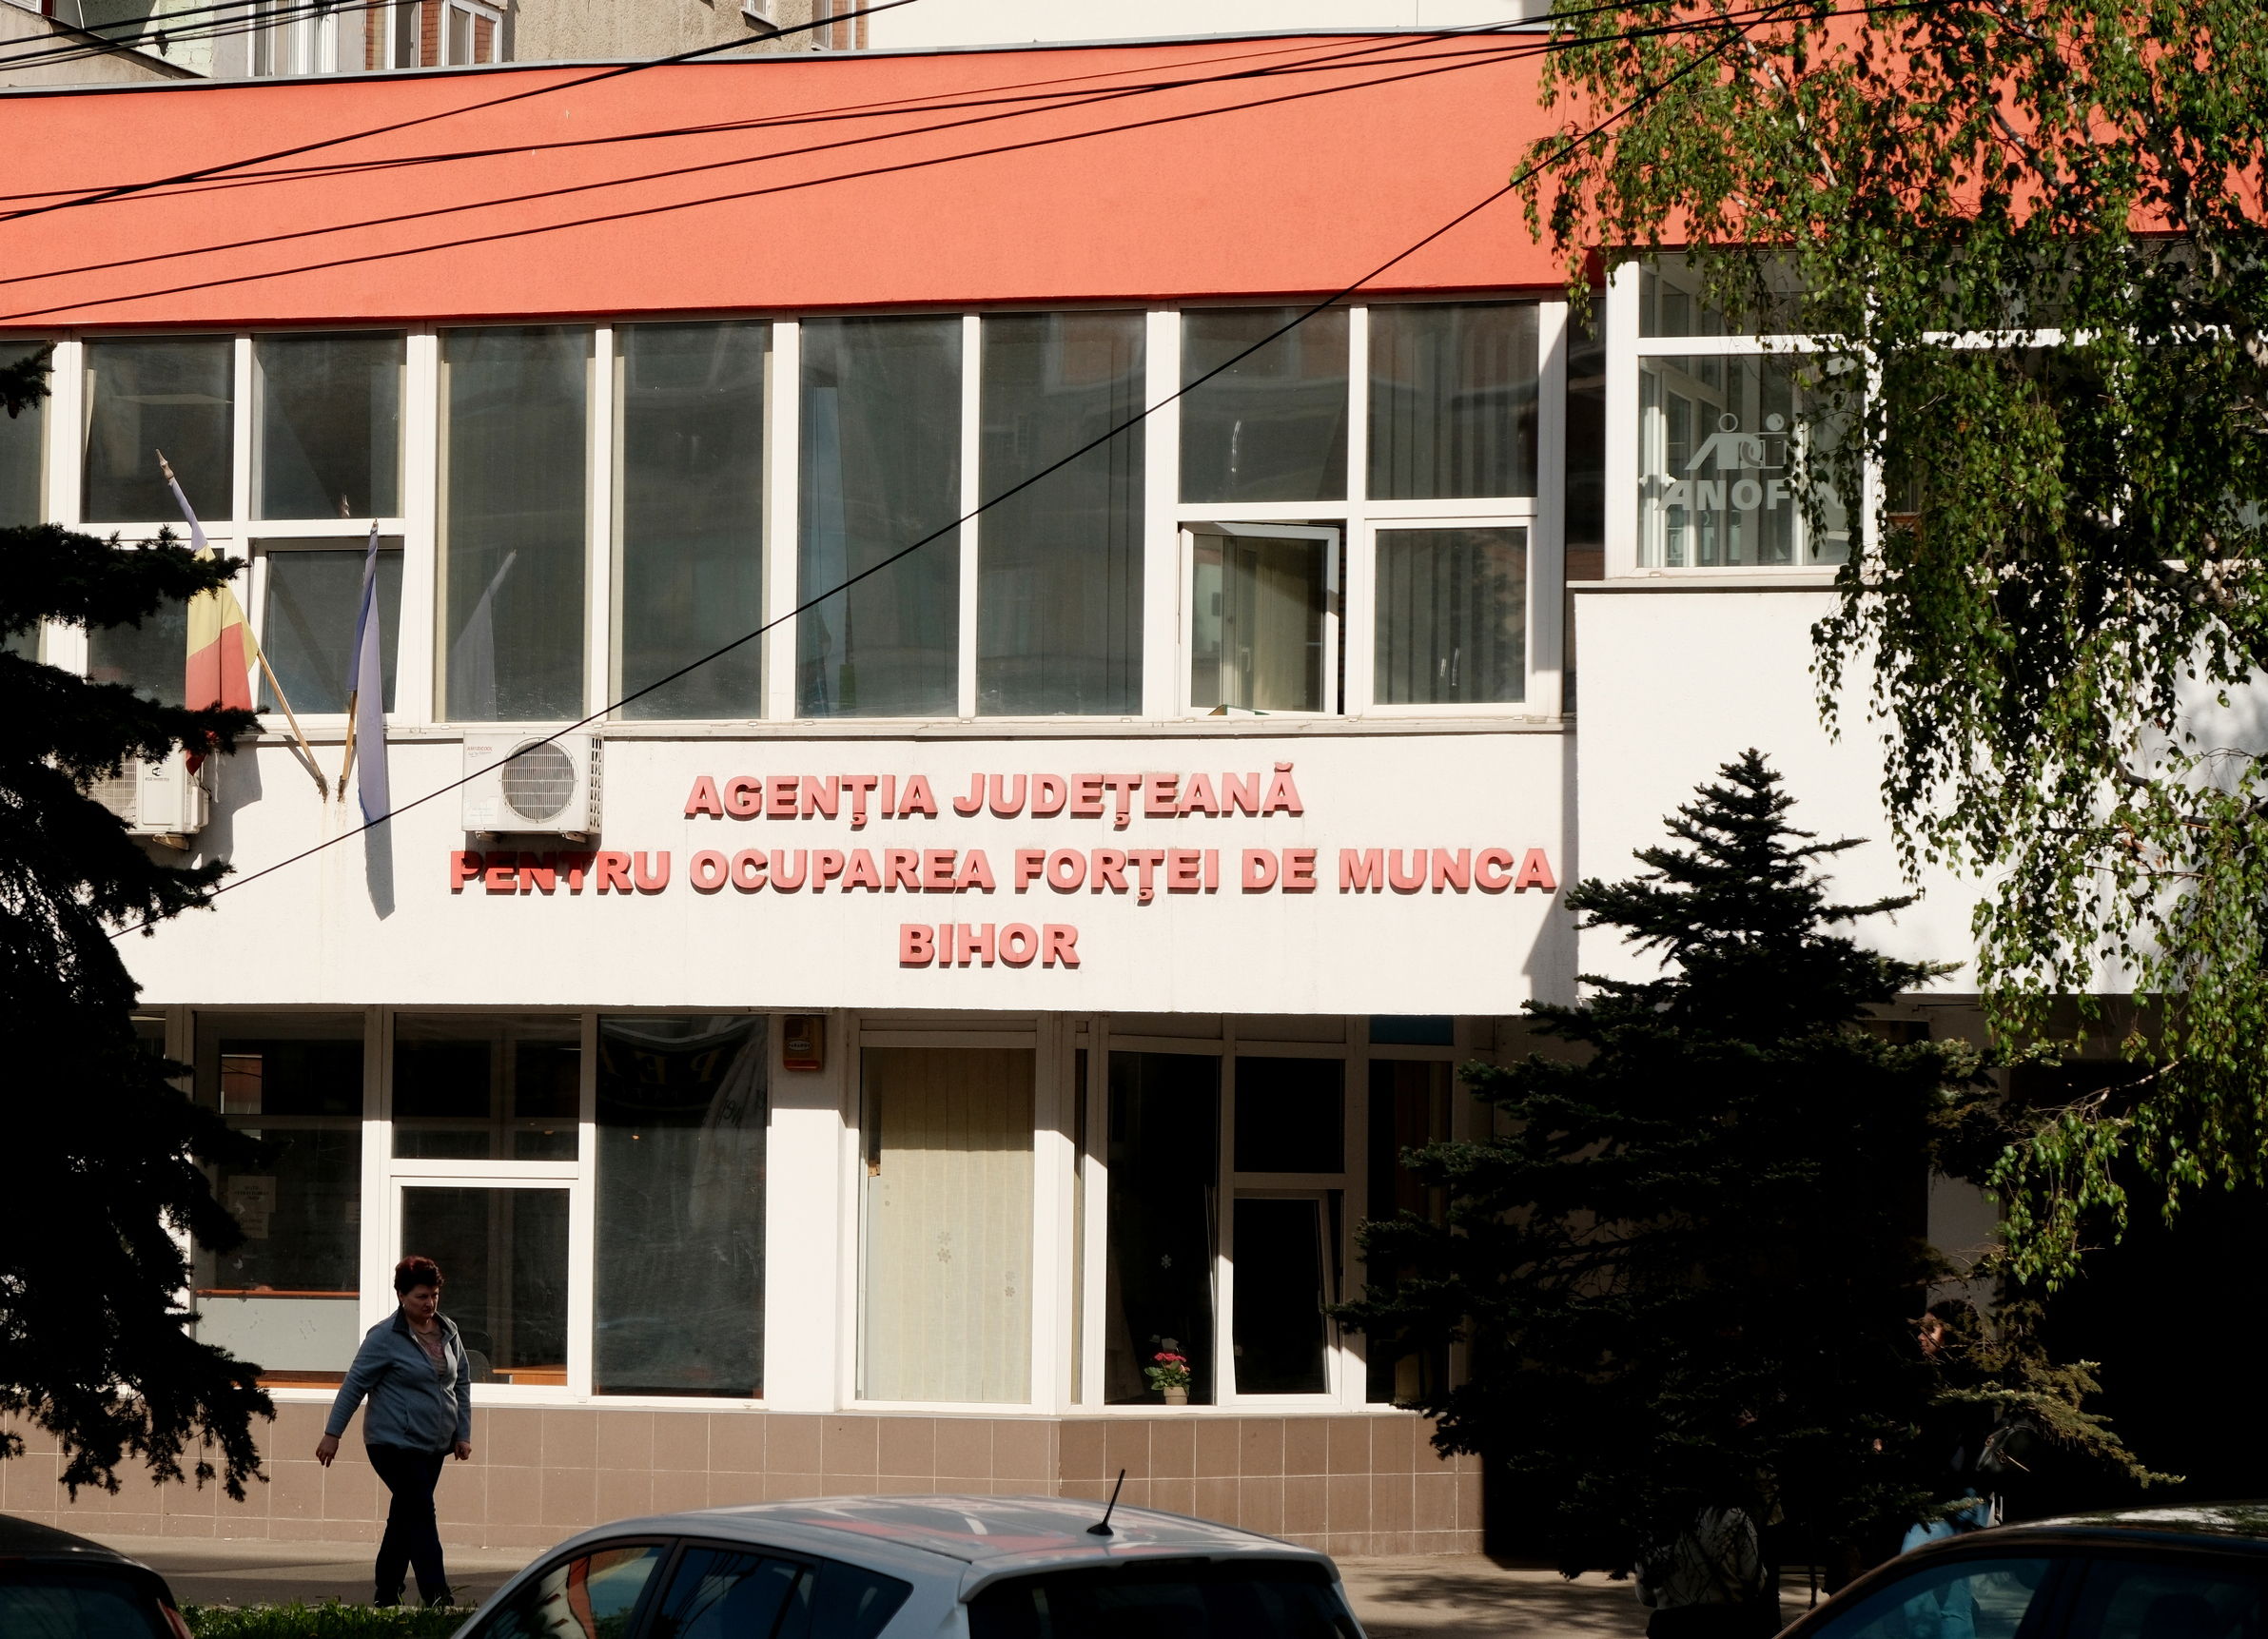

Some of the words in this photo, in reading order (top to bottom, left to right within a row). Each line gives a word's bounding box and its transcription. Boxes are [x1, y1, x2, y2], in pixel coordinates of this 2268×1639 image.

[450, 850, 672, 894] PENTRU
[690, 849, 996, 894] OCUPAREA
[1242, 848, 1319, 894] DE
[1339, 847, 1557, 894] MUNCA
[899, 923, 1081, 968] BIHOR
